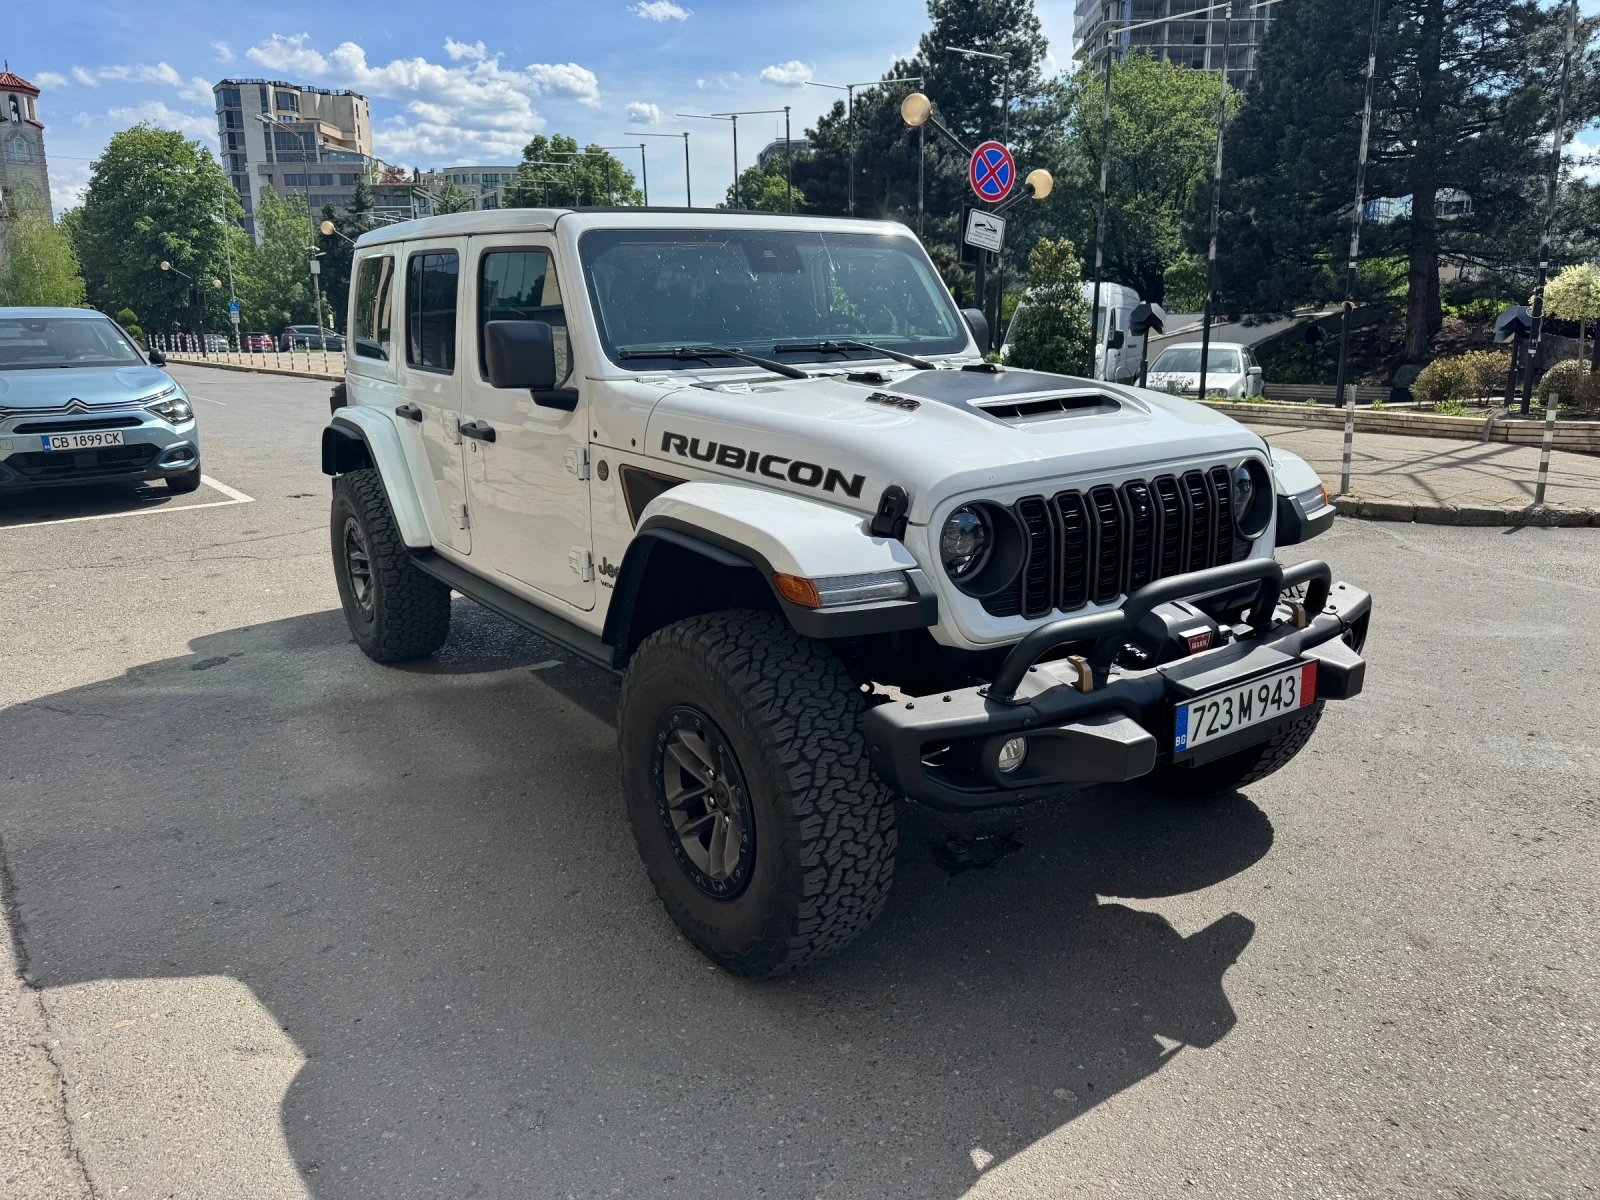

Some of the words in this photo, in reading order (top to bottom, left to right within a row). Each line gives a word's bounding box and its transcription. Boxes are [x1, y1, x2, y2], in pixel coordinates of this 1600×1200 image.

[52, 437, 70, 448] CB
[73, 434, 102, 447] 1899
[104, 432, 121, 444] CK
[660, 430, 867, 499] RUBICON
[1191, 696, 1234, 742] 723
[1238, 689, 1253, 724] M
[1257, 675, 1296, 717] 943
[1175, 734, 1186, 747] BG
